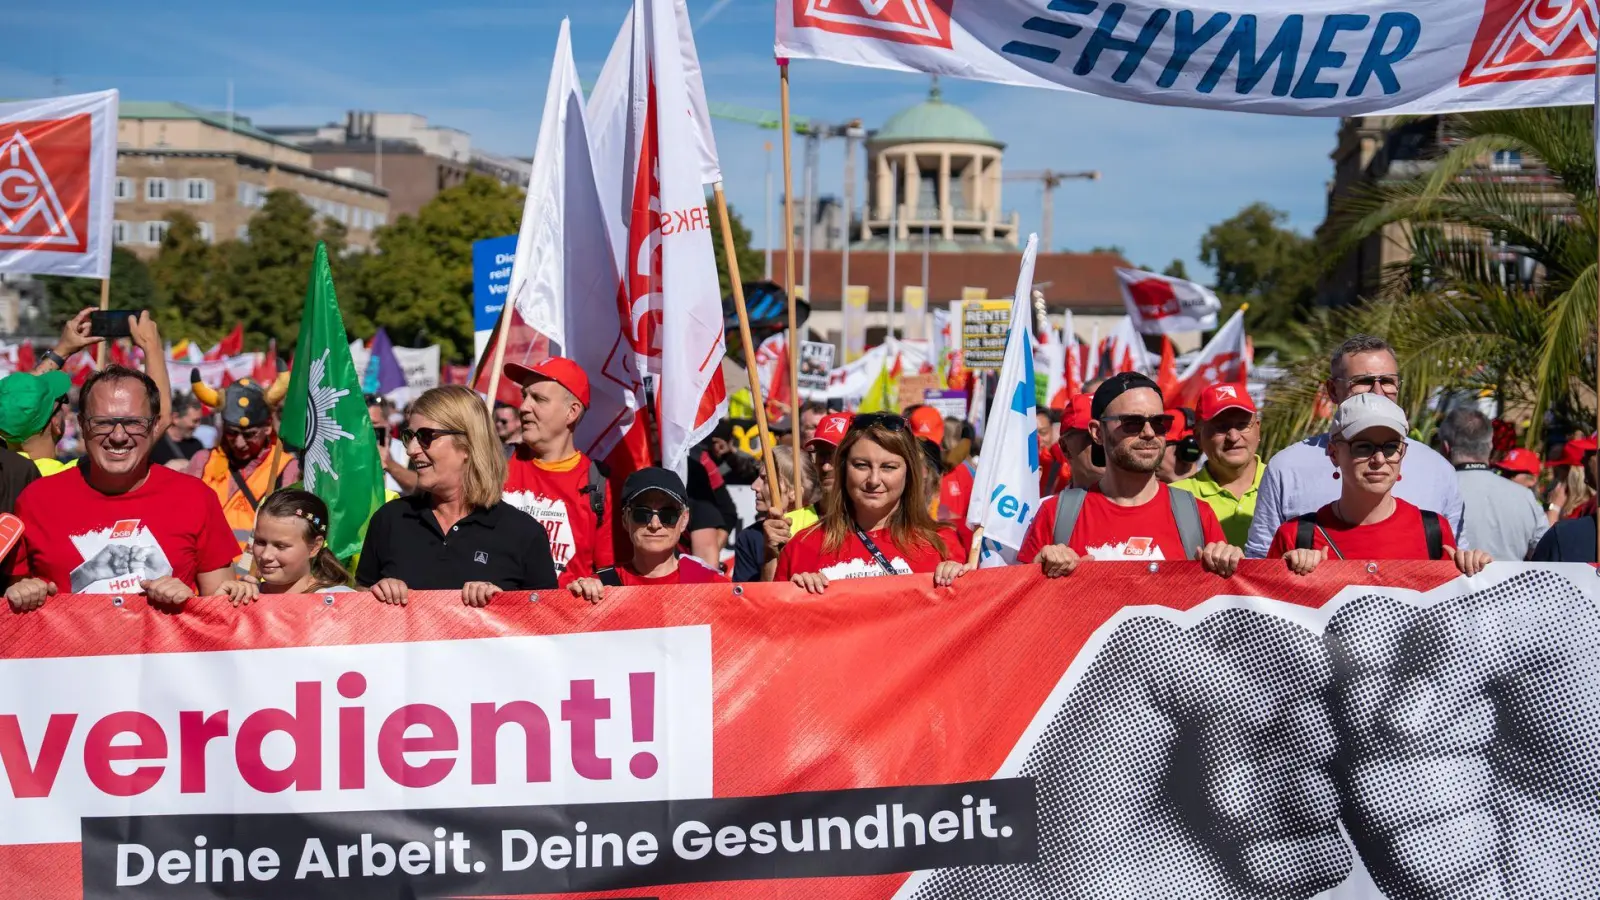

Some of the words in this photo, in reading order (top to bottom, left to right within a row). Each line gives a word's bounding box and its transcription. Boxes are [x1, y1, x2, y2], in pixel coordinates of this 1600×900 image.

[1073, 2, 1421, 99] HYMER
[966, 309, 1009, 321] RENTE
[112, 530, 131, 538] DGB
[1126, 547, 1143, 555] DGB
[0, 671, 659, 798] verdient!
[116, 835, 280, 886] Deine
[295, 827, 486, 880] Arbeit.
[501, 821, 659, 872] Deine
[672, 794, 1014, 861] Gesundheit.
